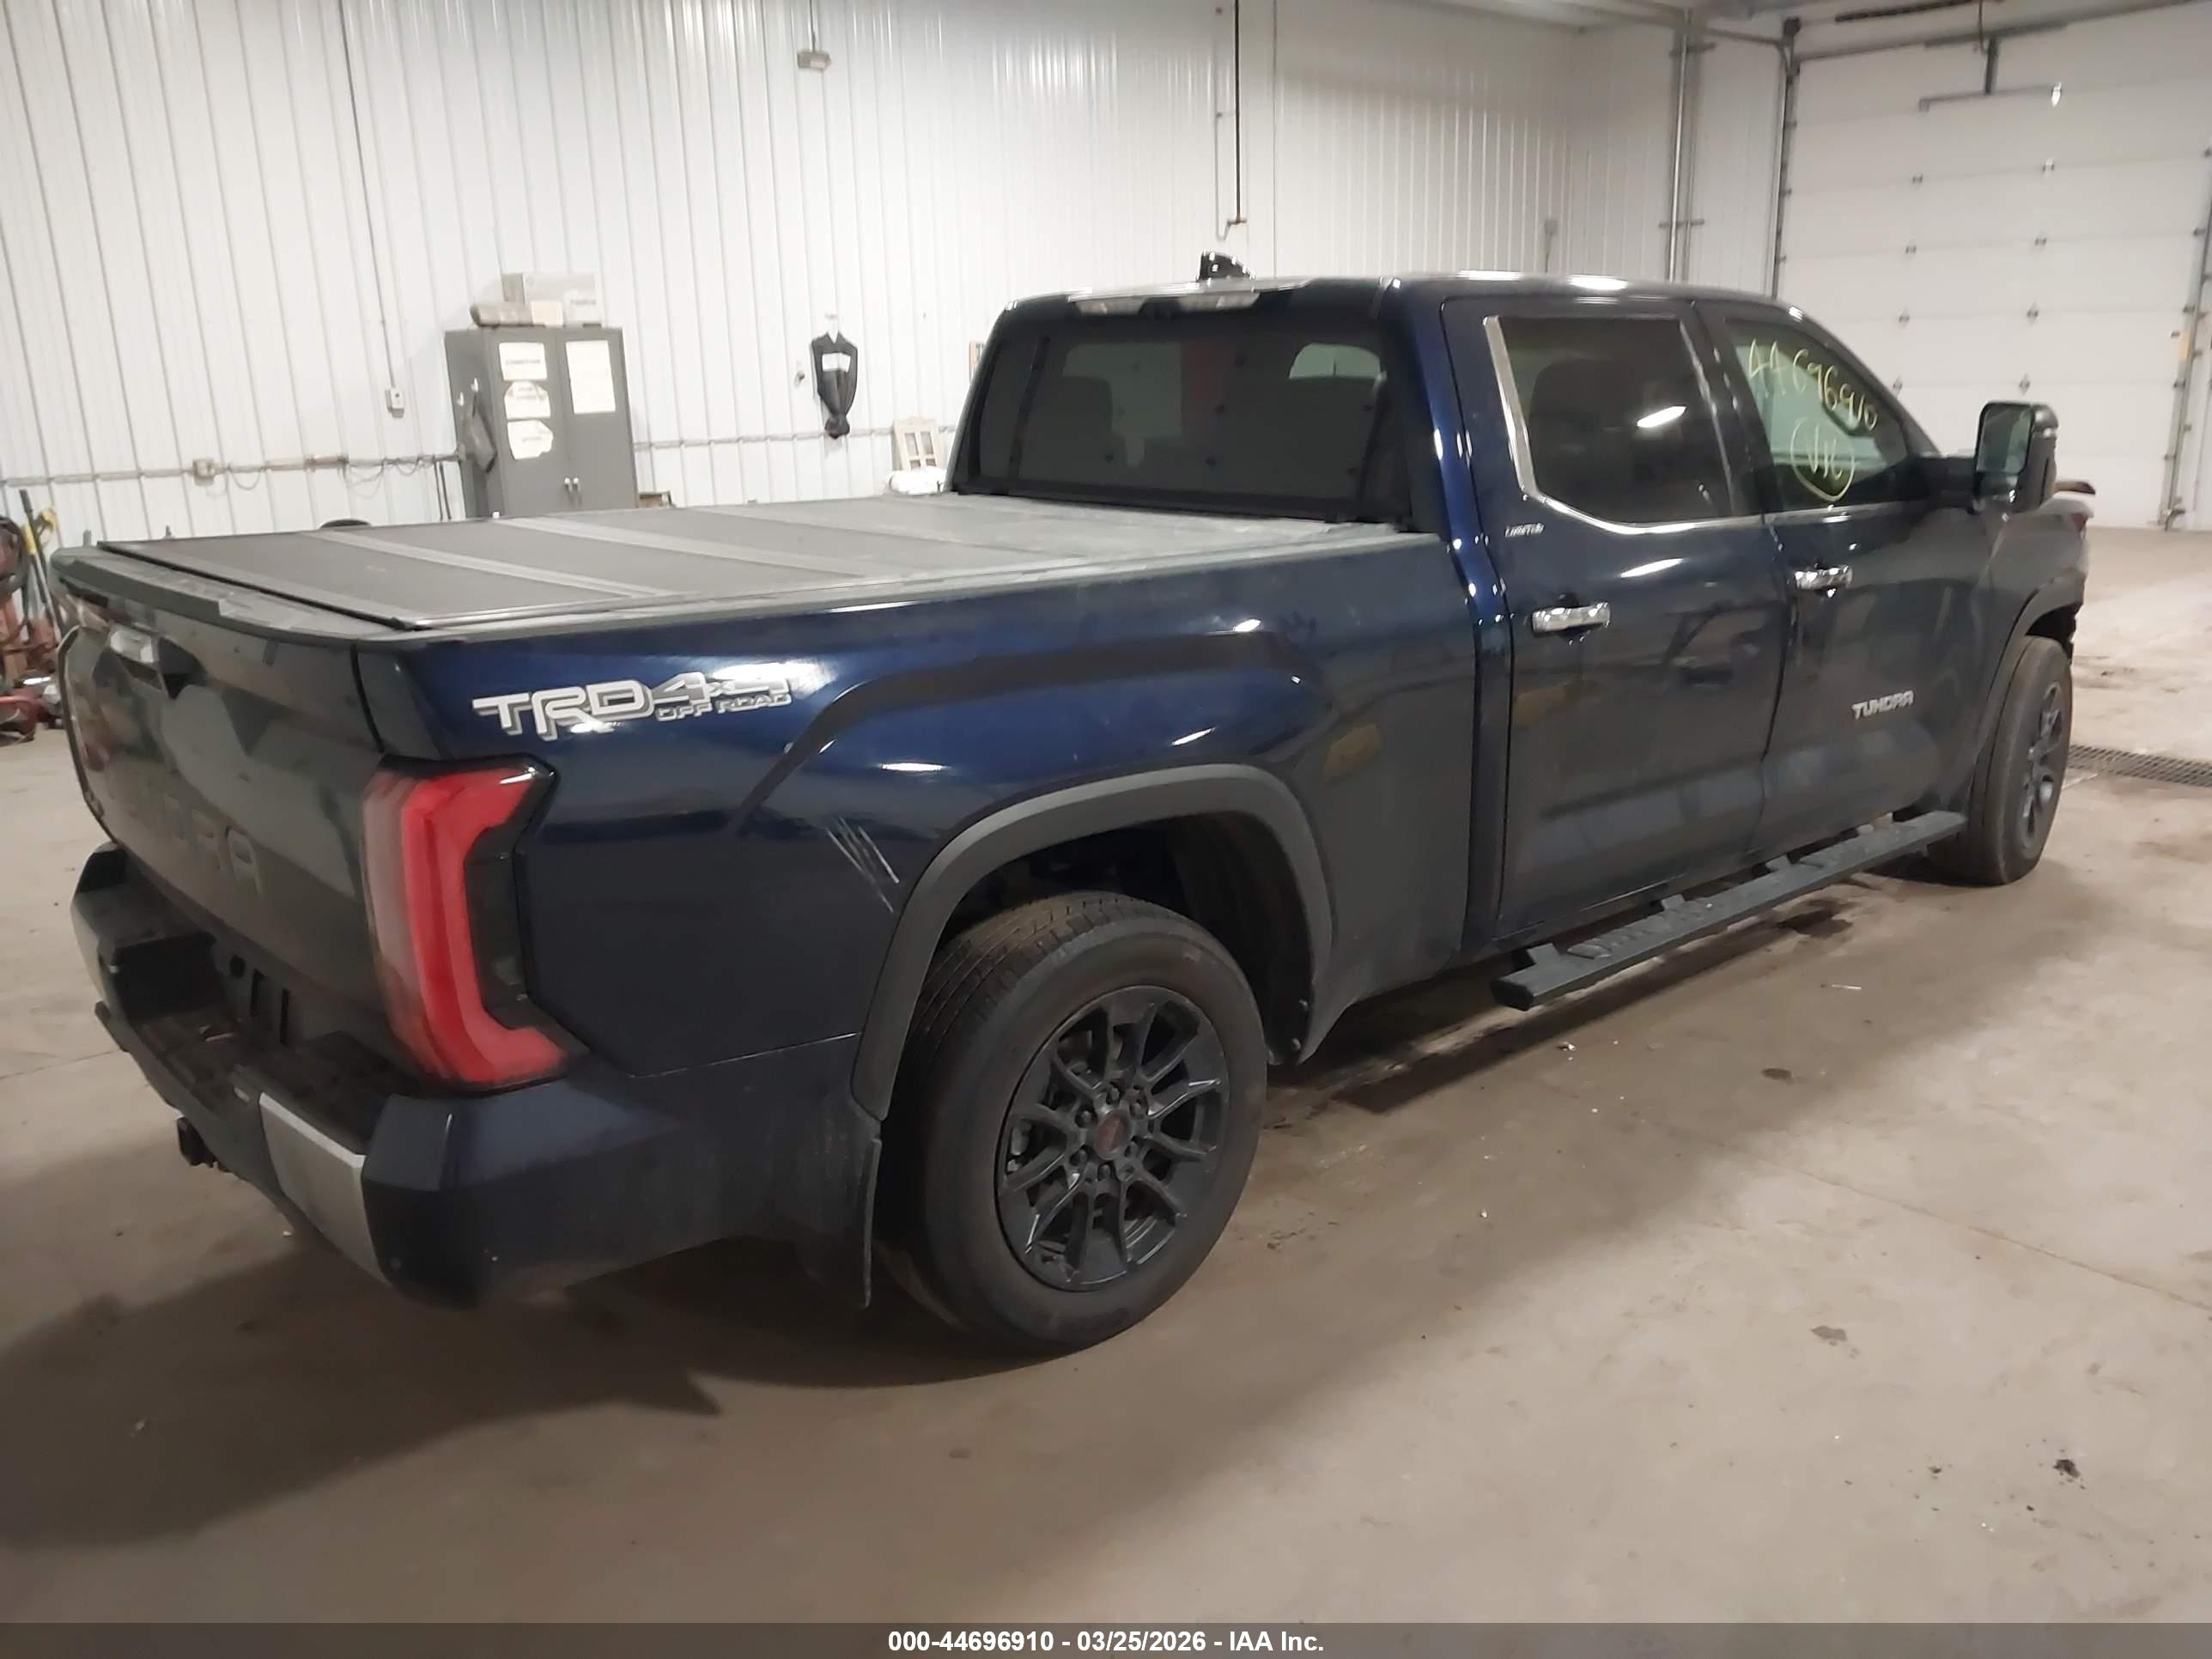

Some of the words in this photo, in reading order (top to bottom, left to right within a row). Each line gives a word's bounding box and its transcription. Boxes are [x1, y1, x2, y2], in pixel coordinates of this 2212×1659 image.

[471, 679, 654, 741] TRD
[655, 702, 714, 722] OFF
[714, 694, 792, 714] ROAD
[1851, 690, 1915, 720] TUNDRA
